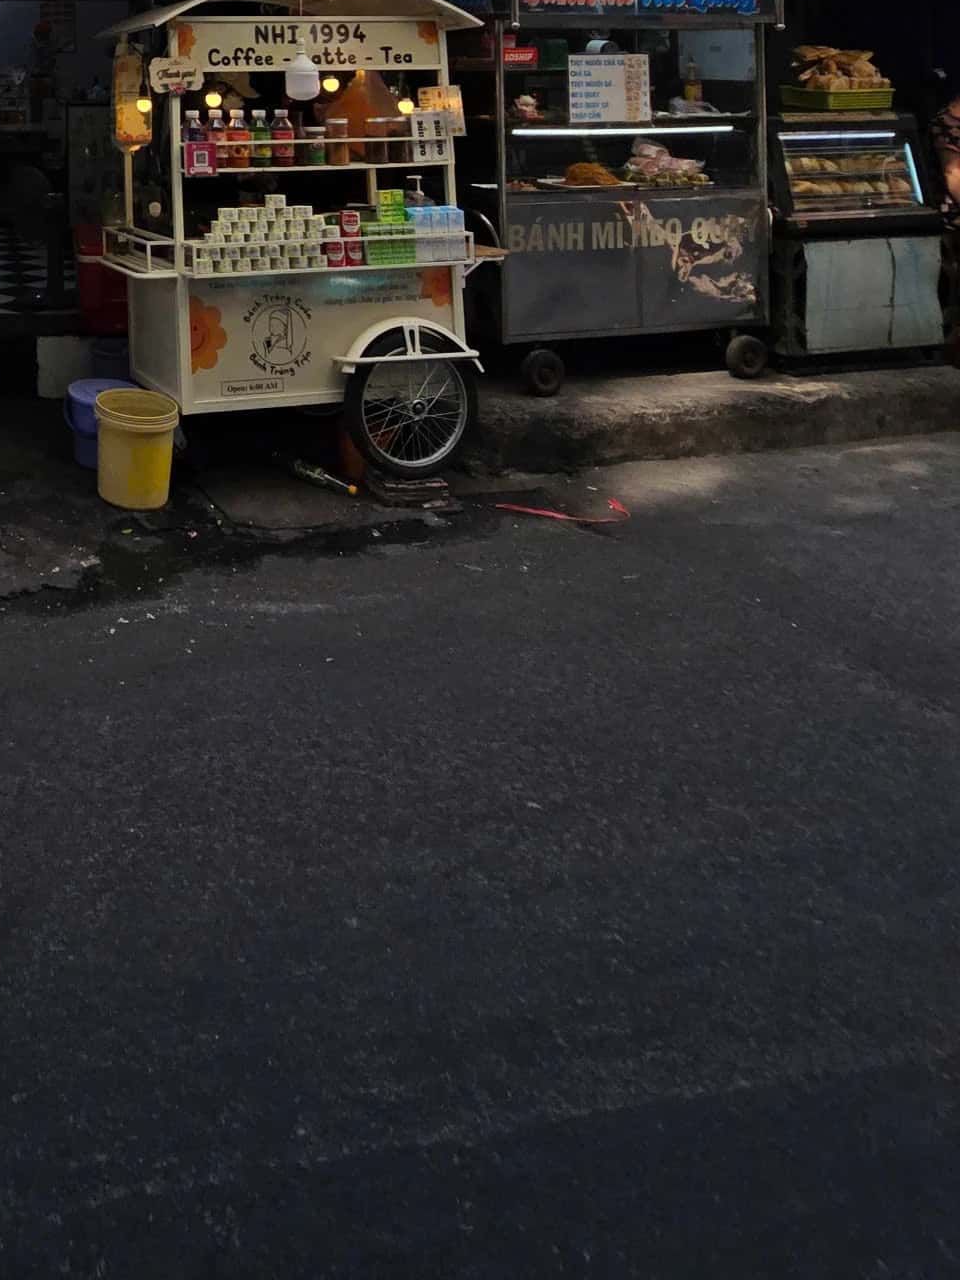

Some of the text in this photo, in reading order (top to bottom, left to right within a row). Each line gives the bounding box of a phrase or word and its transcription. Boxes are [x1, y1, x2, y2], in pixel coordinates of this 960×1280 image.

[254, 24, 367, 44] NHI 1994
[208, 47, 274, 66] Coffee
[311, 47, 357, 65] atte
[380, 47, 413, 64] Tea
[509, 217, 585, 253] BÁNH
